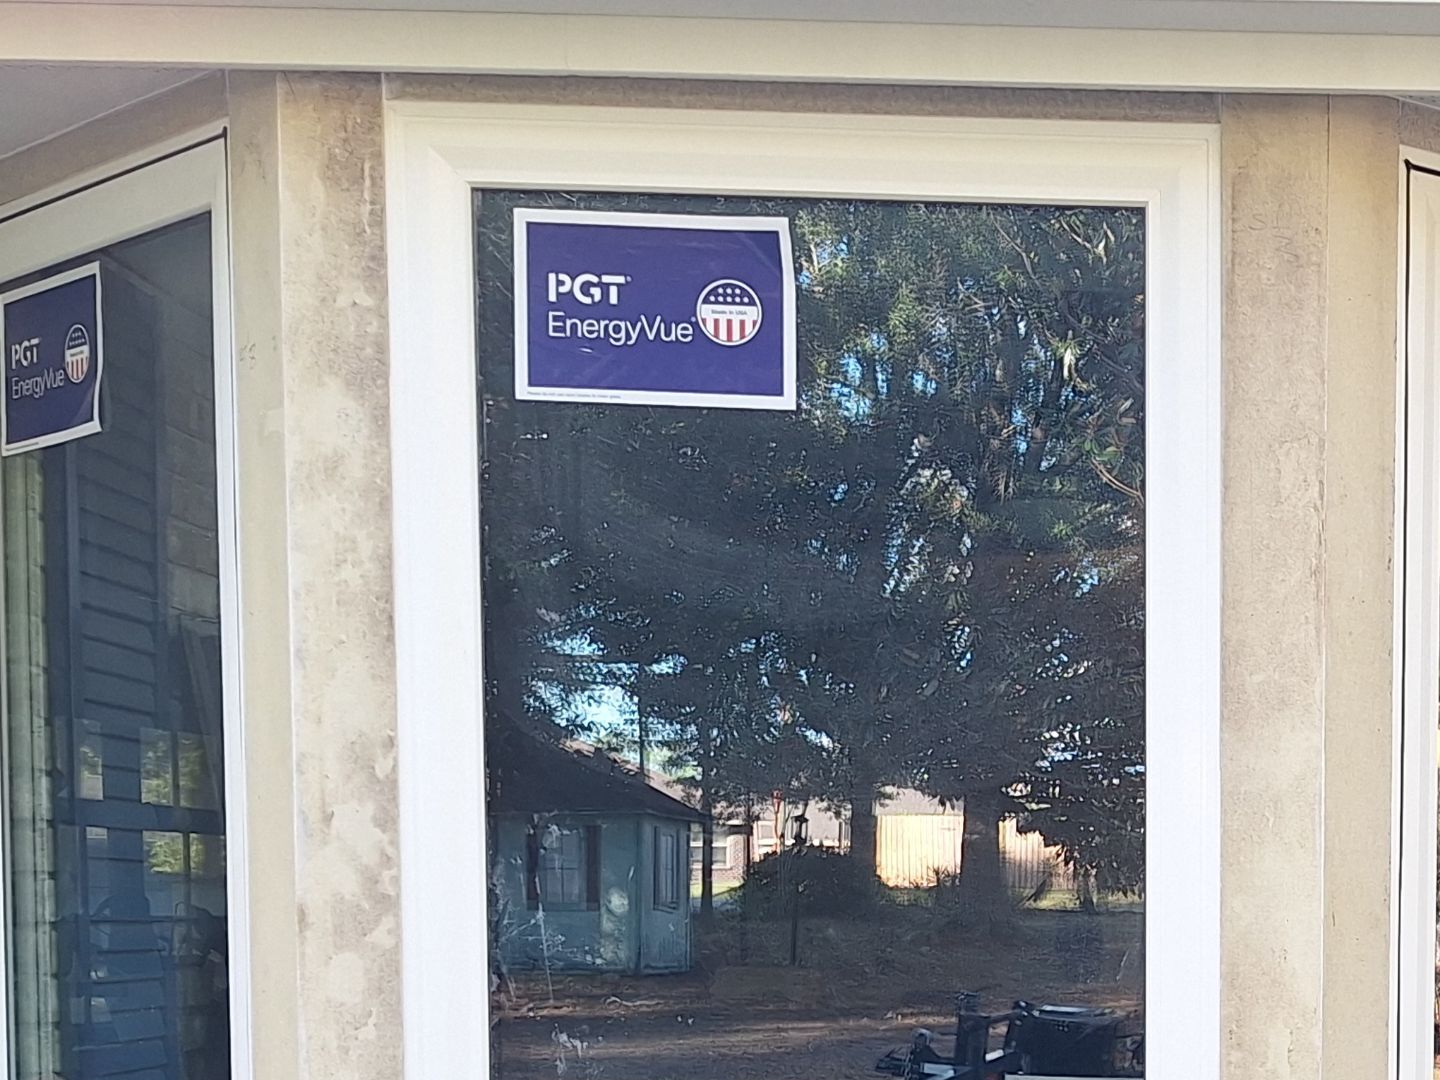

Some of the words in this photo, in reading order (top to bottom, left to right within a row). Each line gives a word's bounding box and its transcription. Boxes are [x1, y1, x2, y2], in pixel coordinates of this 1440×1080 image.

[548, 272, 627, 305] PGT
[548, 311, 694, 346] EnergyVue
[11, 338, 40, 370] PGT
[12, 368, 65, 399] EnergyVue
